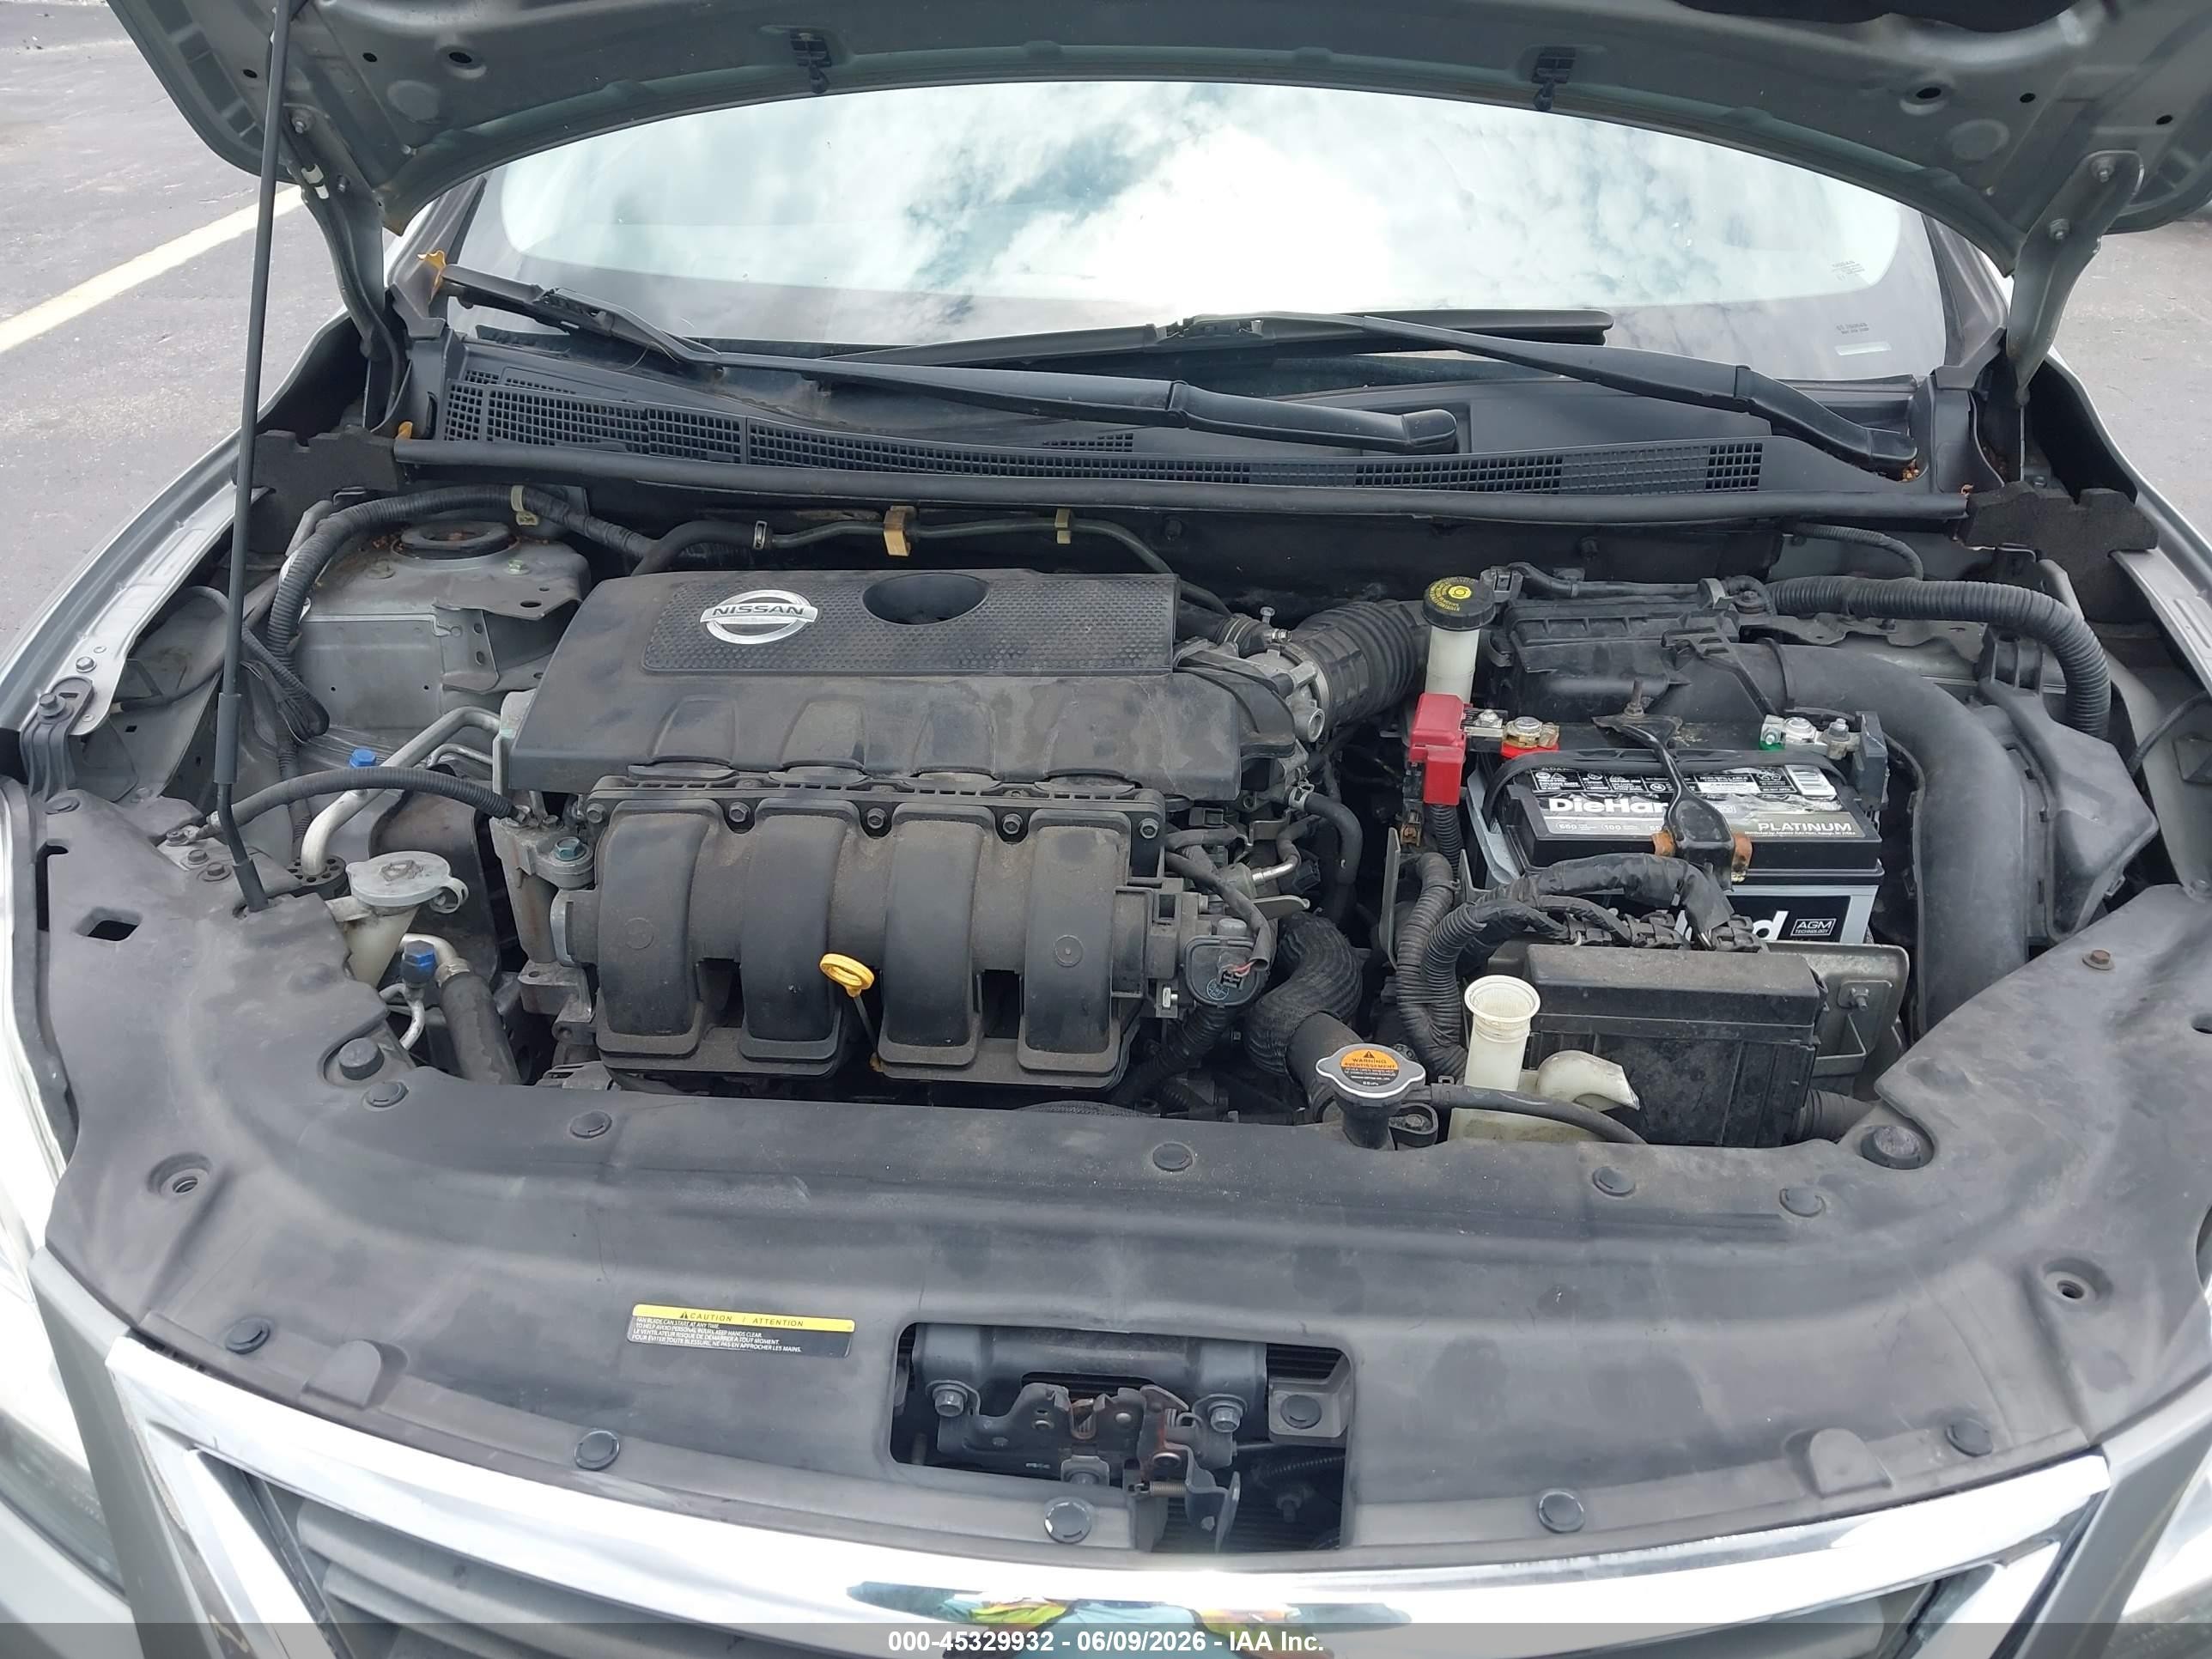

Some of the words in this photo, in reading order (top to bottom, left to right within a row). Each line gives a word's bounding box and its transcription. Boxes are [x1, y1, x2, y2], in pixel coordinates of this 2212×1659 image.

[712, 605, 804, 616] NISSAN
[1549, 798, 1669, 813] DieHar
[1758, 823, 1852, 832] PLATINUM
[690, 1313, 732, 1322] CAUTION
[753, 1318, 803, 1326] ATTENTION
